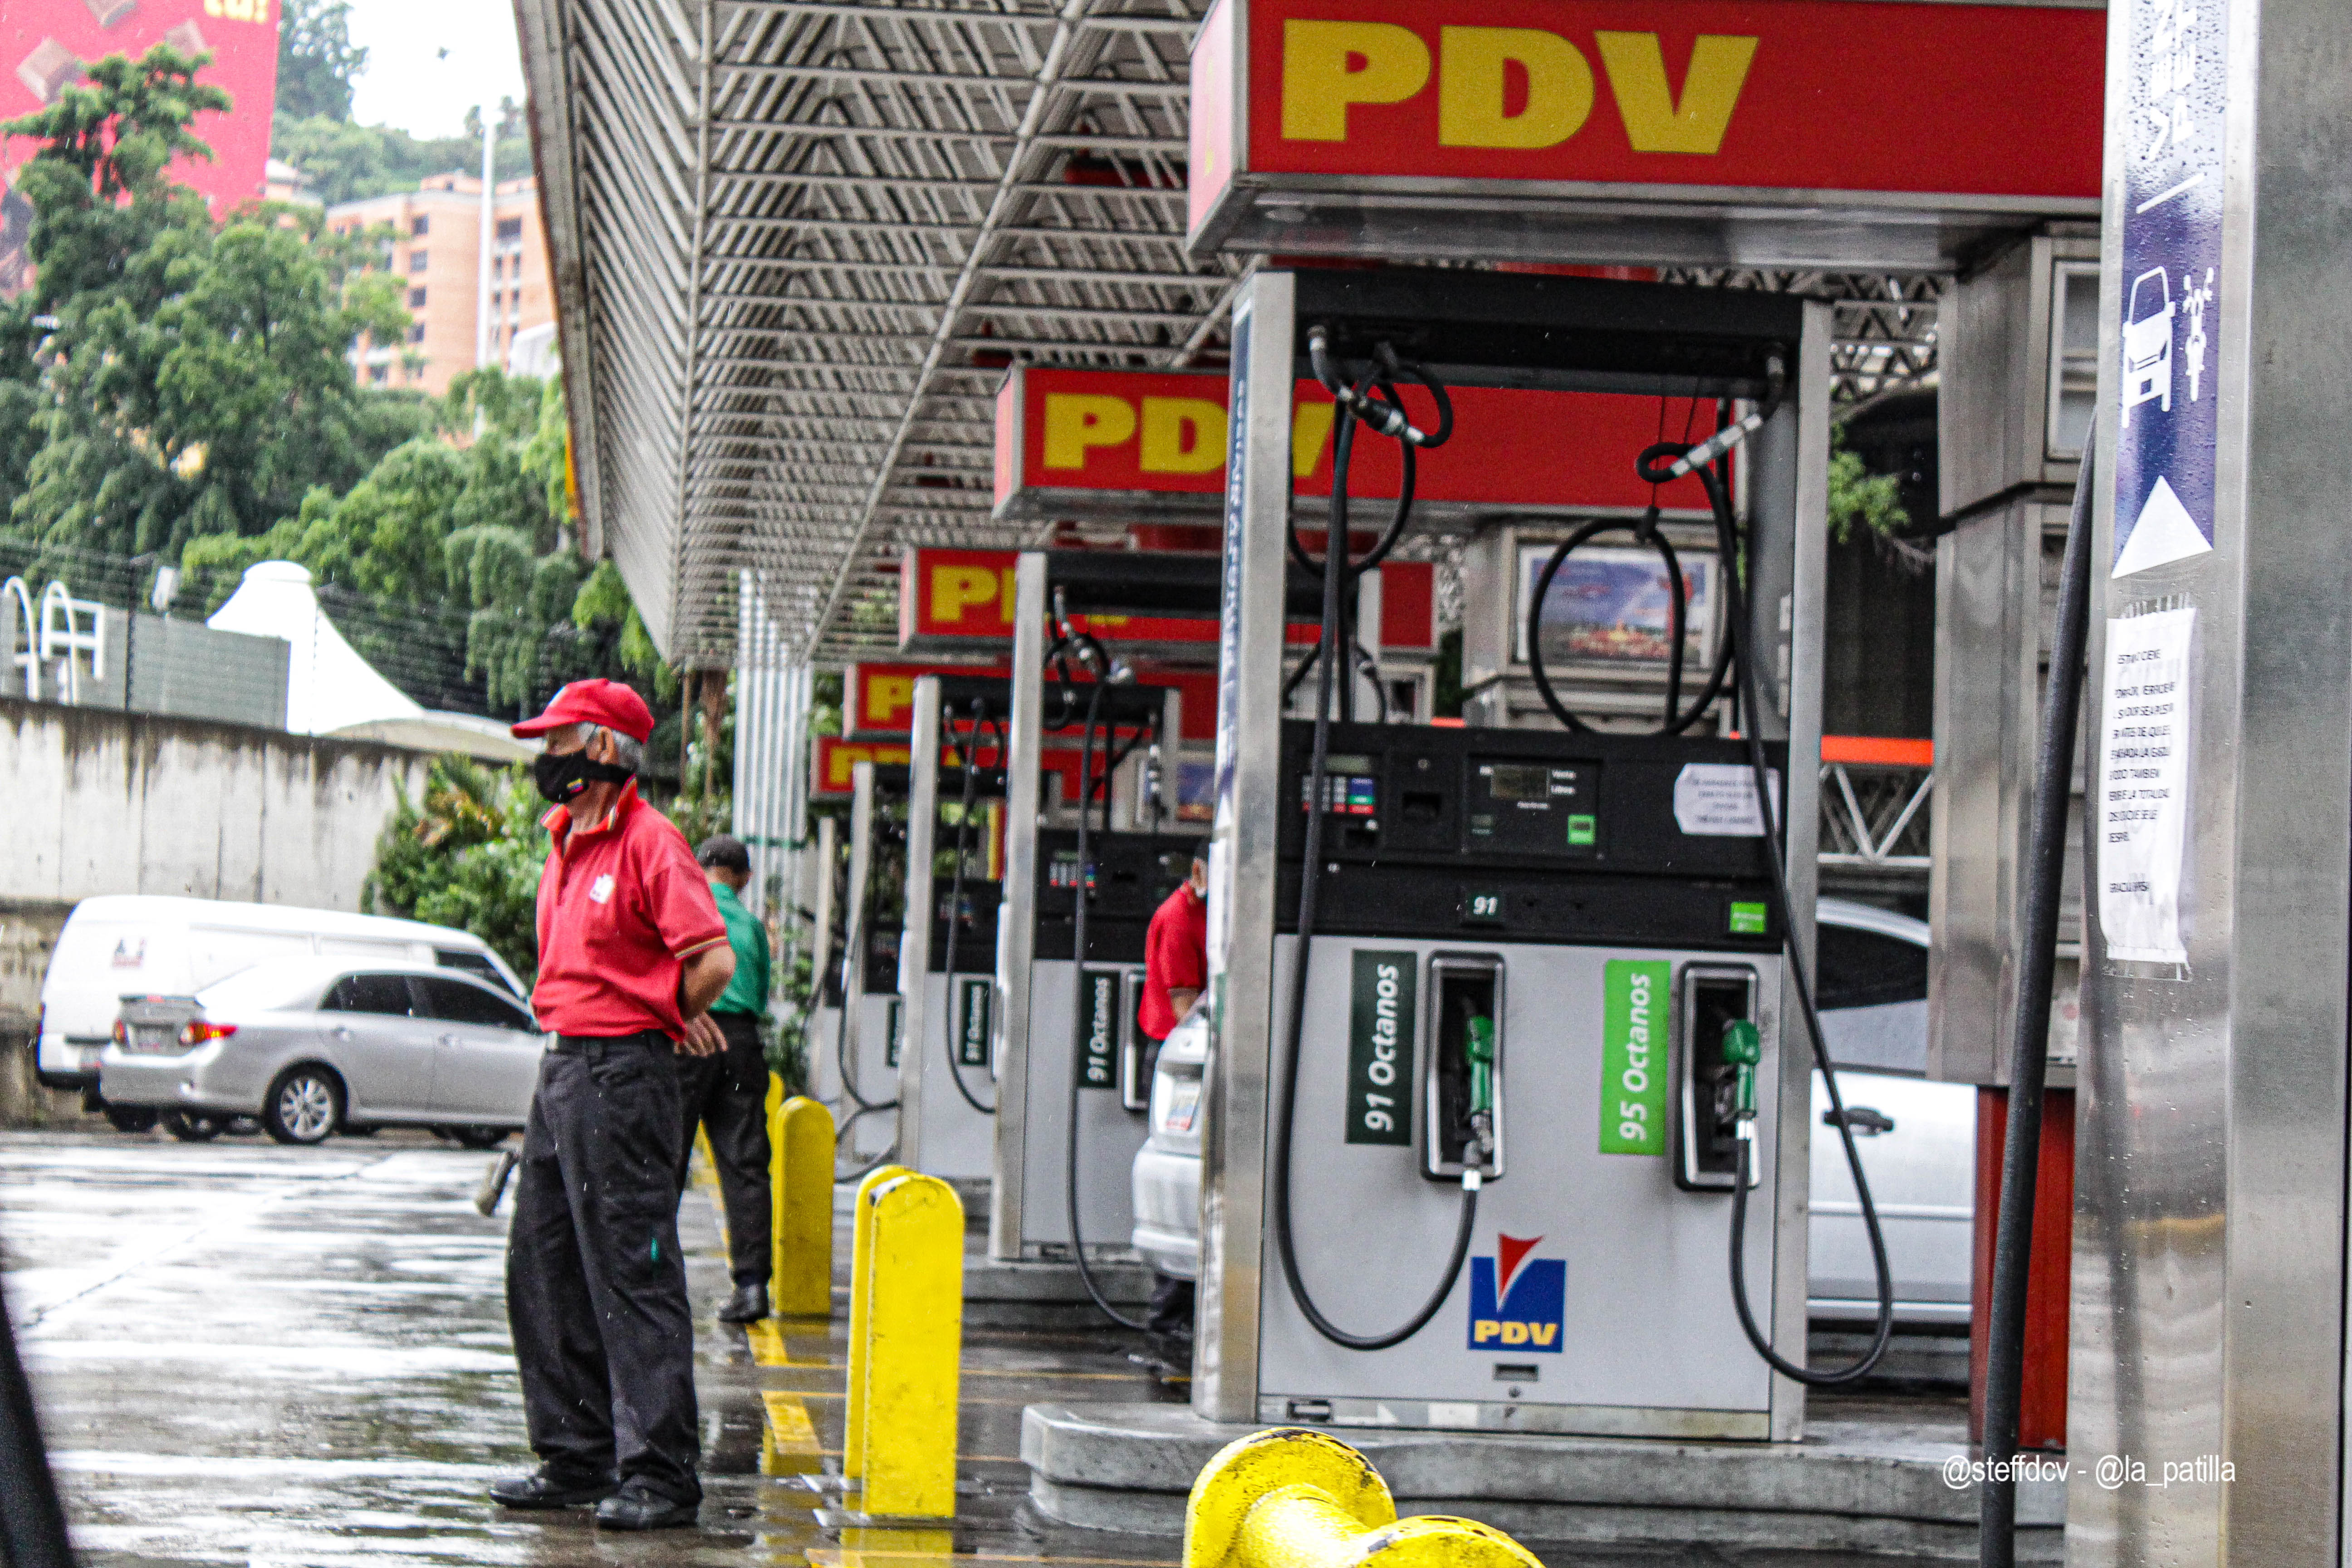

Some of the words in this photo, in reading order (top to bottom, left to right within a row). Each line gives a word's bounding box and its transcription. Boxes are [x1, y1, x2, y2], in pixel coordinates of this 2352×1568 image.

[1281, 19, 1760, 155] PDV
[1473, 896, 1498, 915] 91
[1089, 976, 1109, 1054] Octanos
[1368, 964, 1399, 1086] Octanos
[1622, 973, 1651, 1093] Octanos
[1087, 1055, 1108, 1082] 91
[1365, 1093, 1395, 1132] 91
[1619, 1100, 1648, 1141] 95
[1474, 1319, 1558, 1346] PDV
